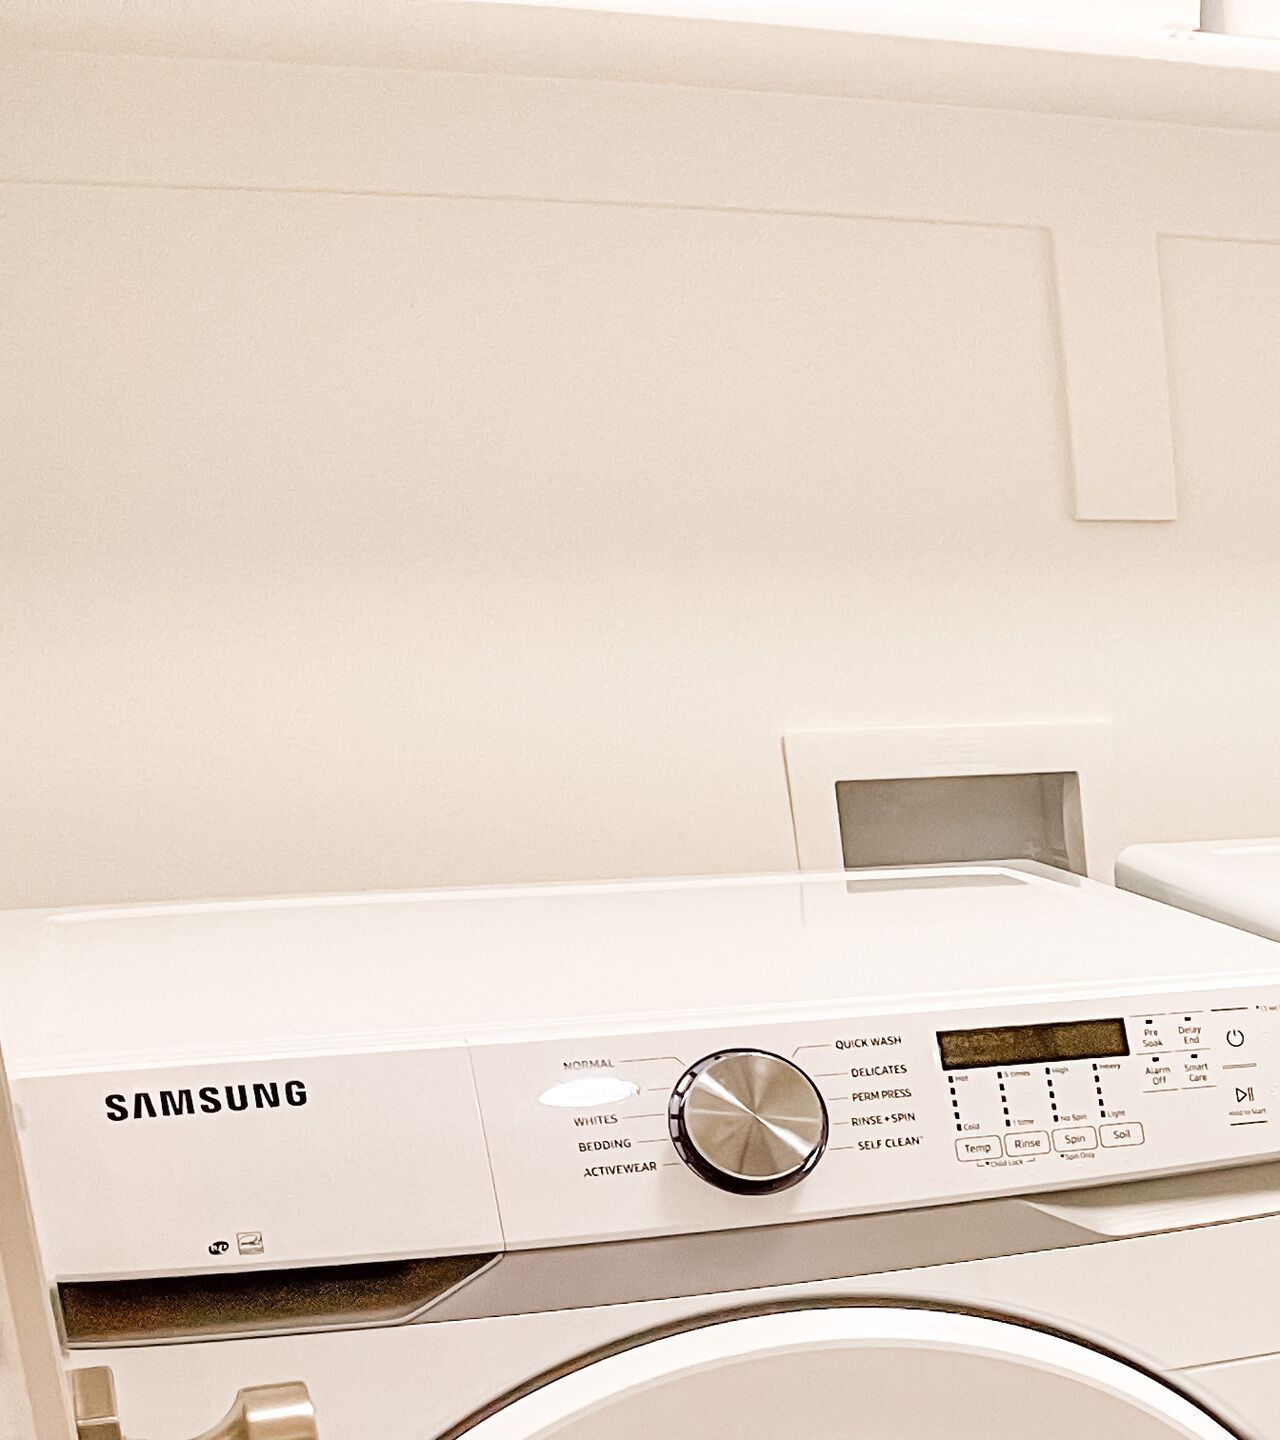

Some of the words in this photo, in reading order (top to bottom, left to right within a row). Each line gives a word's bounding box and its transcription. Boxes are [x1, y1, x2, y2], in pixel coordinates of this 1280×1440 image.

[1178, 1026, 1202, 1035] Delay
[835, 1038, 869, 1050] QUICK
[871, 1036, 902, 1047] WASH
[1143, 1039, 1163, 1048] Soak
[1184, 1036, 1200, 1045] End
[563, 1059, 615, 1071] NORMAL
[1146, 1066, 1171, 1075] Alarm
[1184, 1063, 1208, 1072] Smart
[851, 1064, 907, 1078] DELICATES
[1152, 1076, 1166, 1085] Off
[1189, 1073, 1207, 1082] Care
[105, 1080, 308, 1121] SAMSUNG
[852, 1091, 880, 1102] PERM
[881, 1088, 912, 1099] PRESS
[574, 1114, 618, 1127] WHITES
[851, 1115, 883, 1126] RINSE
[892, 1112, 916, 1122] SPIN
[1064, 1134, 1086, 1145] Spin
[1113, 1129, 1131, 1139] Soil
[578, 1138, 632, 1152] BEDDING
[858, 1140, 882, 1151] SELF
[965, 1143, 992, 1154] Temp
[1014, 1138, 1041, 1148] Rinse
[584, 1161, 657, 1177] ACTIVEWEAR
